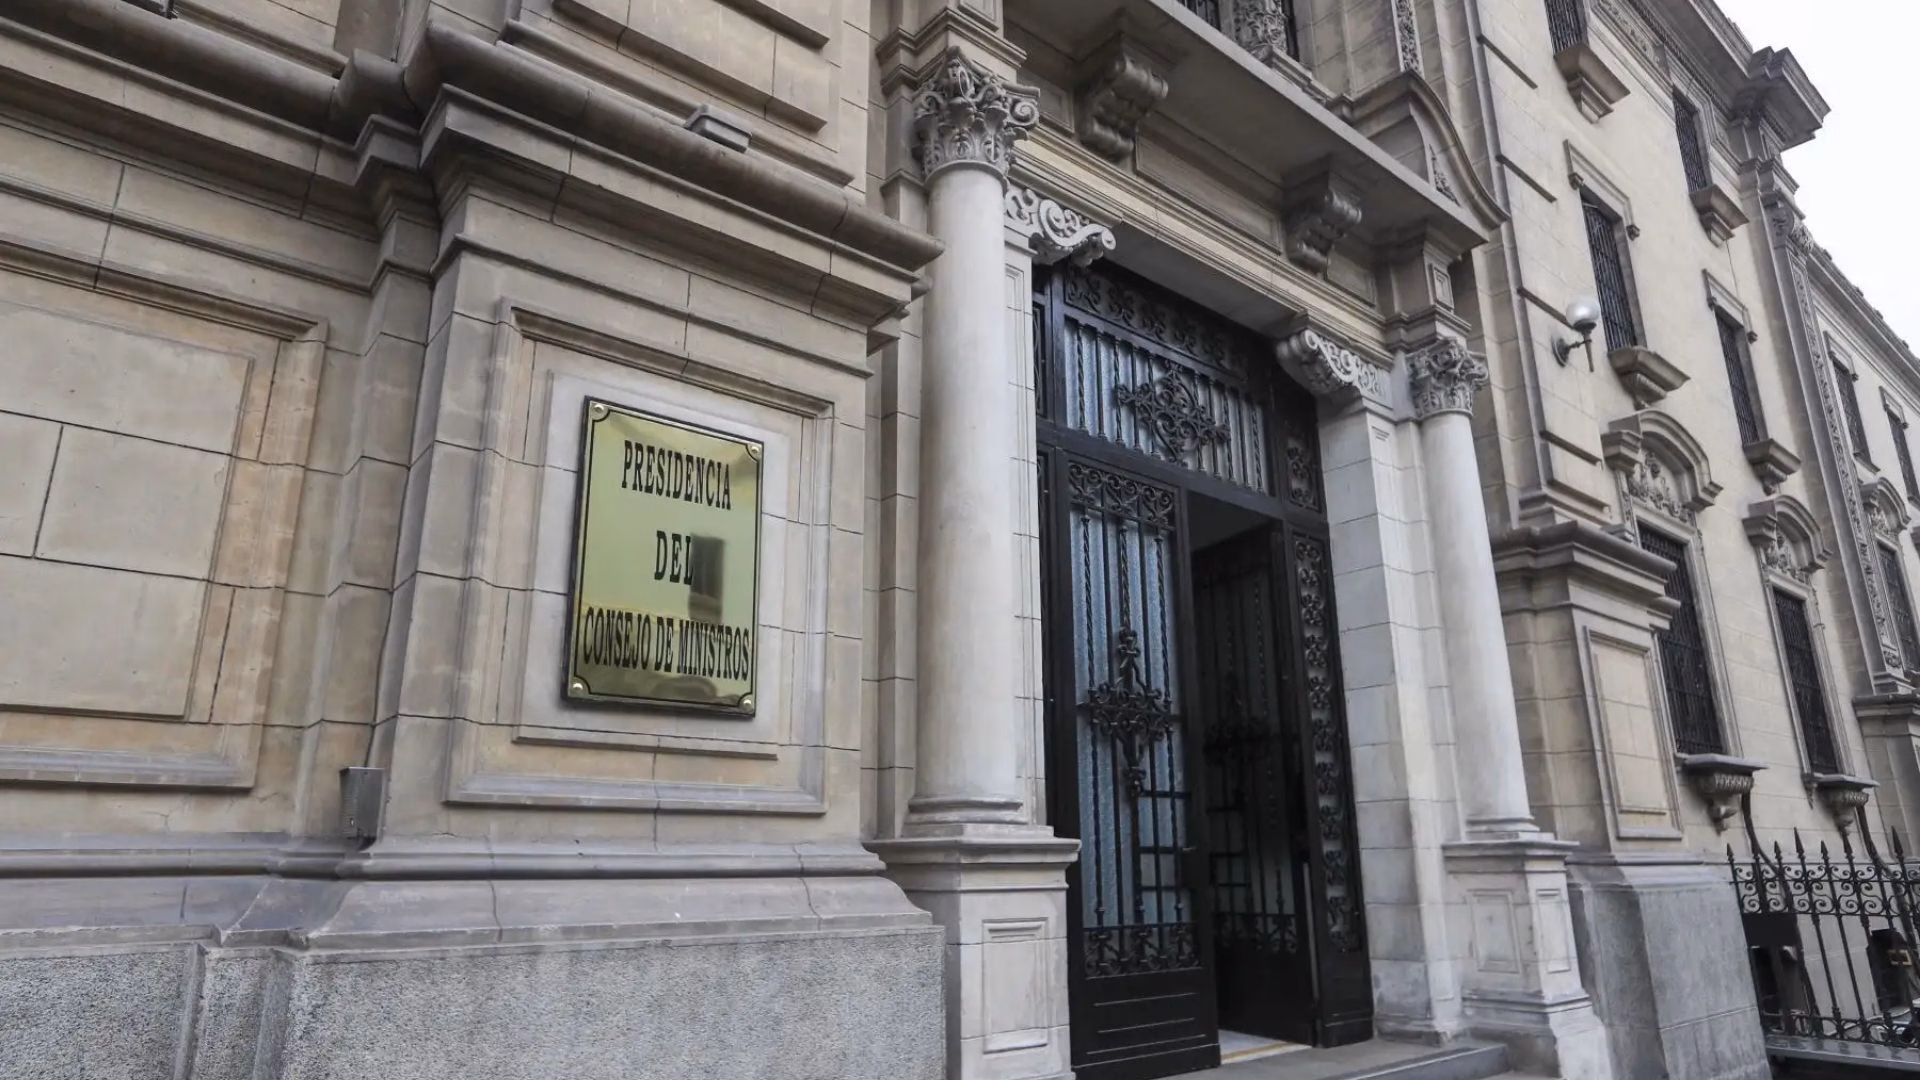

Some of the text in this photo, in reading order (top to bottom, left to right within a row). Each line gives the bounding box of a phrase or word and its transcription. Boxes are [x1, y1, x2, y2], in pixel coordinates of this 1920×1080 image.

[621, 439, 732, 511] PRESIDENCIA
[653, 530, 695, 586] DEL
[582, 606, 750, 682] CONSEJO DE MINISTROS
